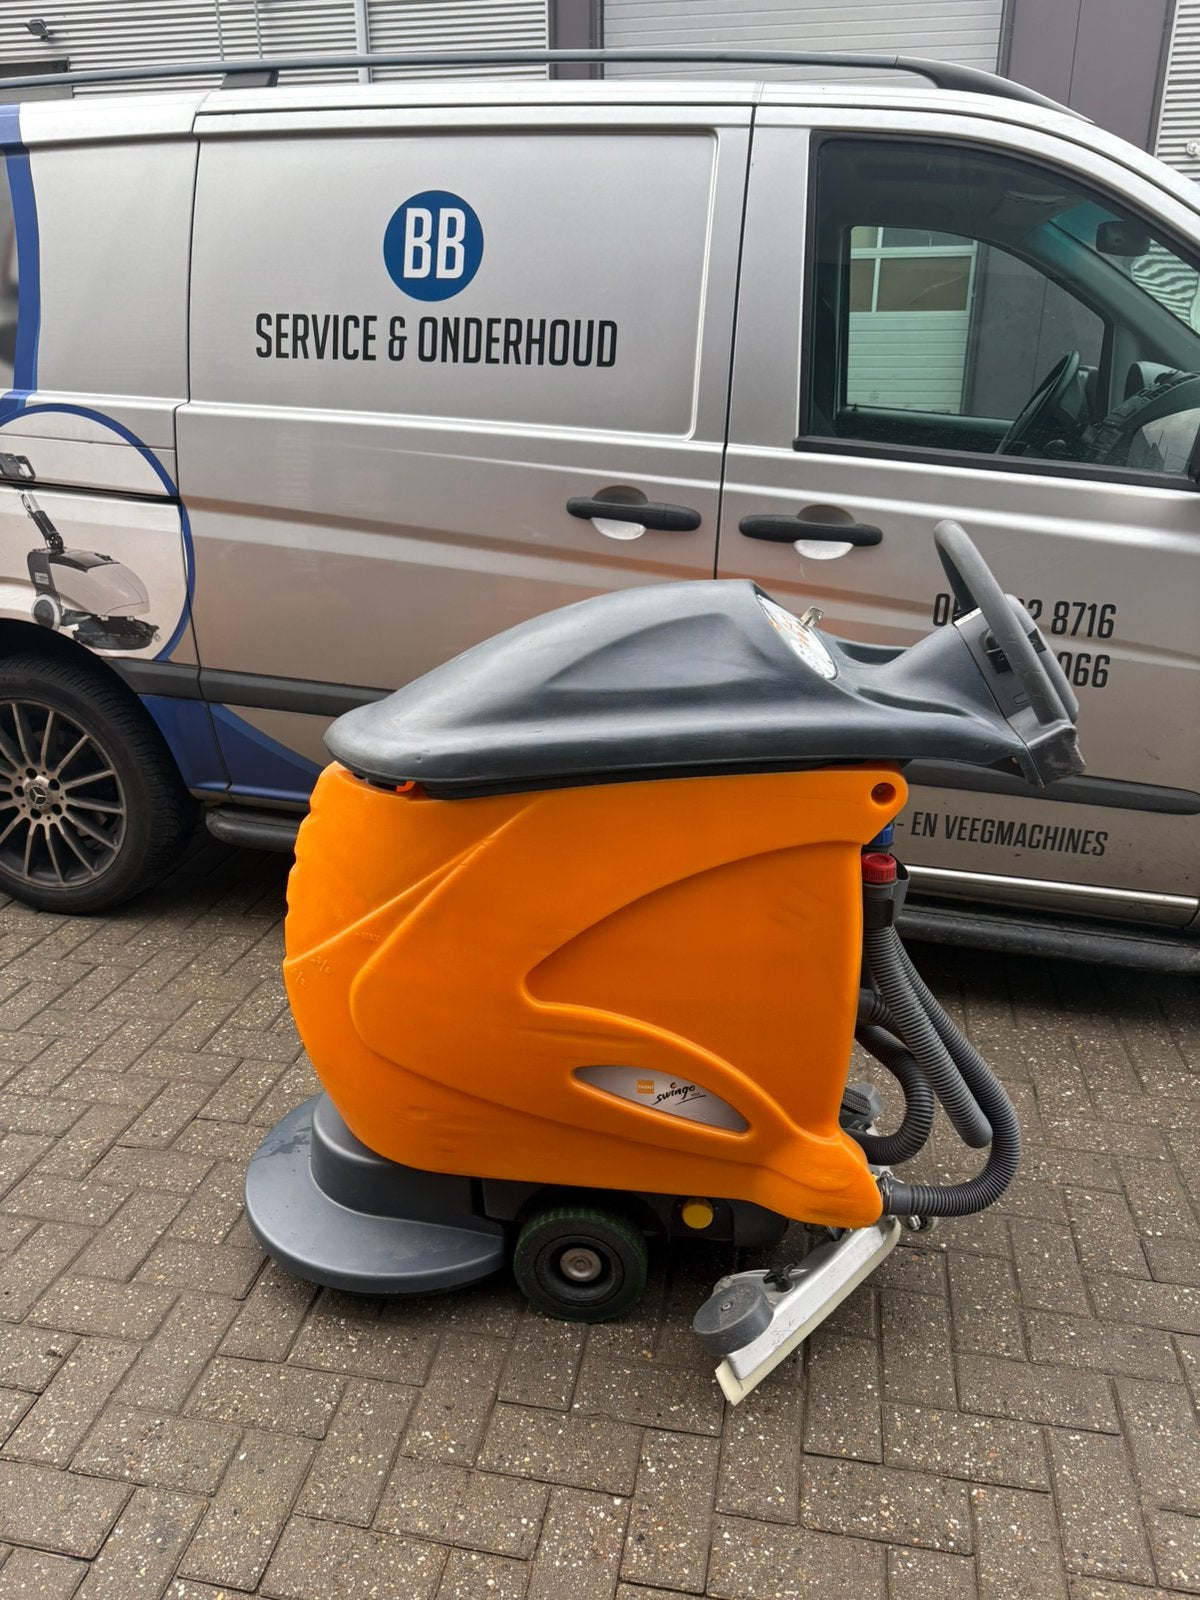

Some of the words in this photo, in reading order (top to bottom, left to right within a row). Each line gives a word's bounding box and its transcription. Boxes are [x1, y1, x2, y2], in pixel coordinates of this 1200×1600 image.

[403, 207, 466, 279] BB
[255, 313, 377, 361] SERVICE
[388, 315, 408, 362] &
[418, 316, 618, 367] ONDERHOUD
[1051, 601, 1117, 639] 8716
[910, 811, 938, 838] EN
[945, 814, 1109, 857] VEEGMACHINES
[652, 1082, 696, 1106] swingo
